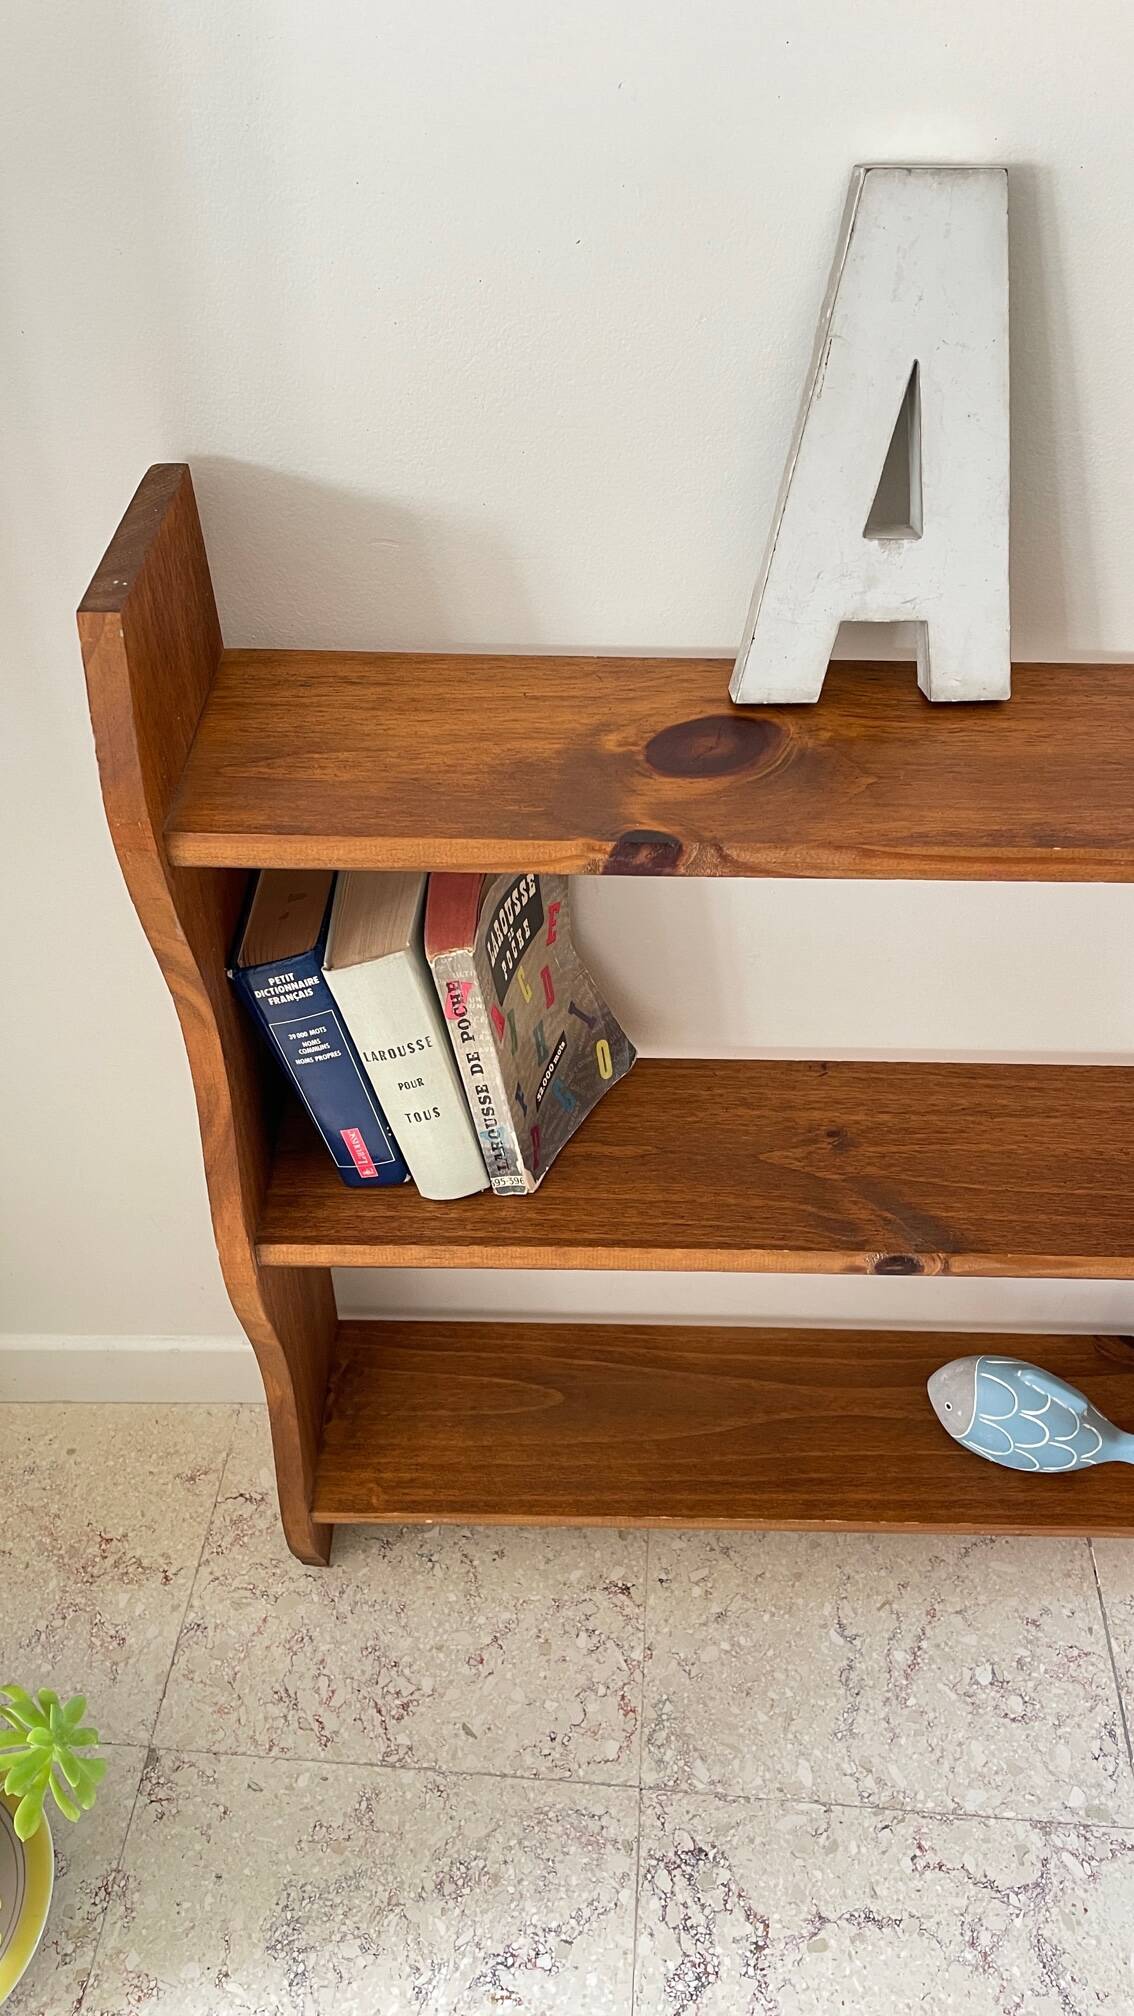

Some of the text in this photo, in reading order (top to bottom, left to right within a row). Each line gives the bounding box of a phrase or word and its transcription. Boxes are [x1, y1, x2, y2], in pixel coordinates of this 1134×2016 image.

[728, 164, 1011, 704] A
[487, 873, 536, 968] LAROUSSE
[501, 918, 531, 981] POCHE
[254, 976, 320, 998] DICTIONNAIRE
[268, 972, 295, 986] PETIT
[268, 988, 314, 1006] FRANÇAIS
[446, 980, 476, 1044] POCHE
[309, 1026, 327, 1037] MOTS
[298, 1043, 331, 1055] COMMUNS
[302, 1038, 321, 1048] NOMS
[363, 1035, 433, 1063] LAROUSSE
[553, 1041, 566, 1065] mots
[295, 1050, 342, 1065] NOMS PROPRES
[466, 1051, 484, 1076] DE
[398, 1077, 425, 1091] POUR
[404, 1107, 441, 1124] TOUS
[475, 1084, 510, 1172] LAROUSSE
